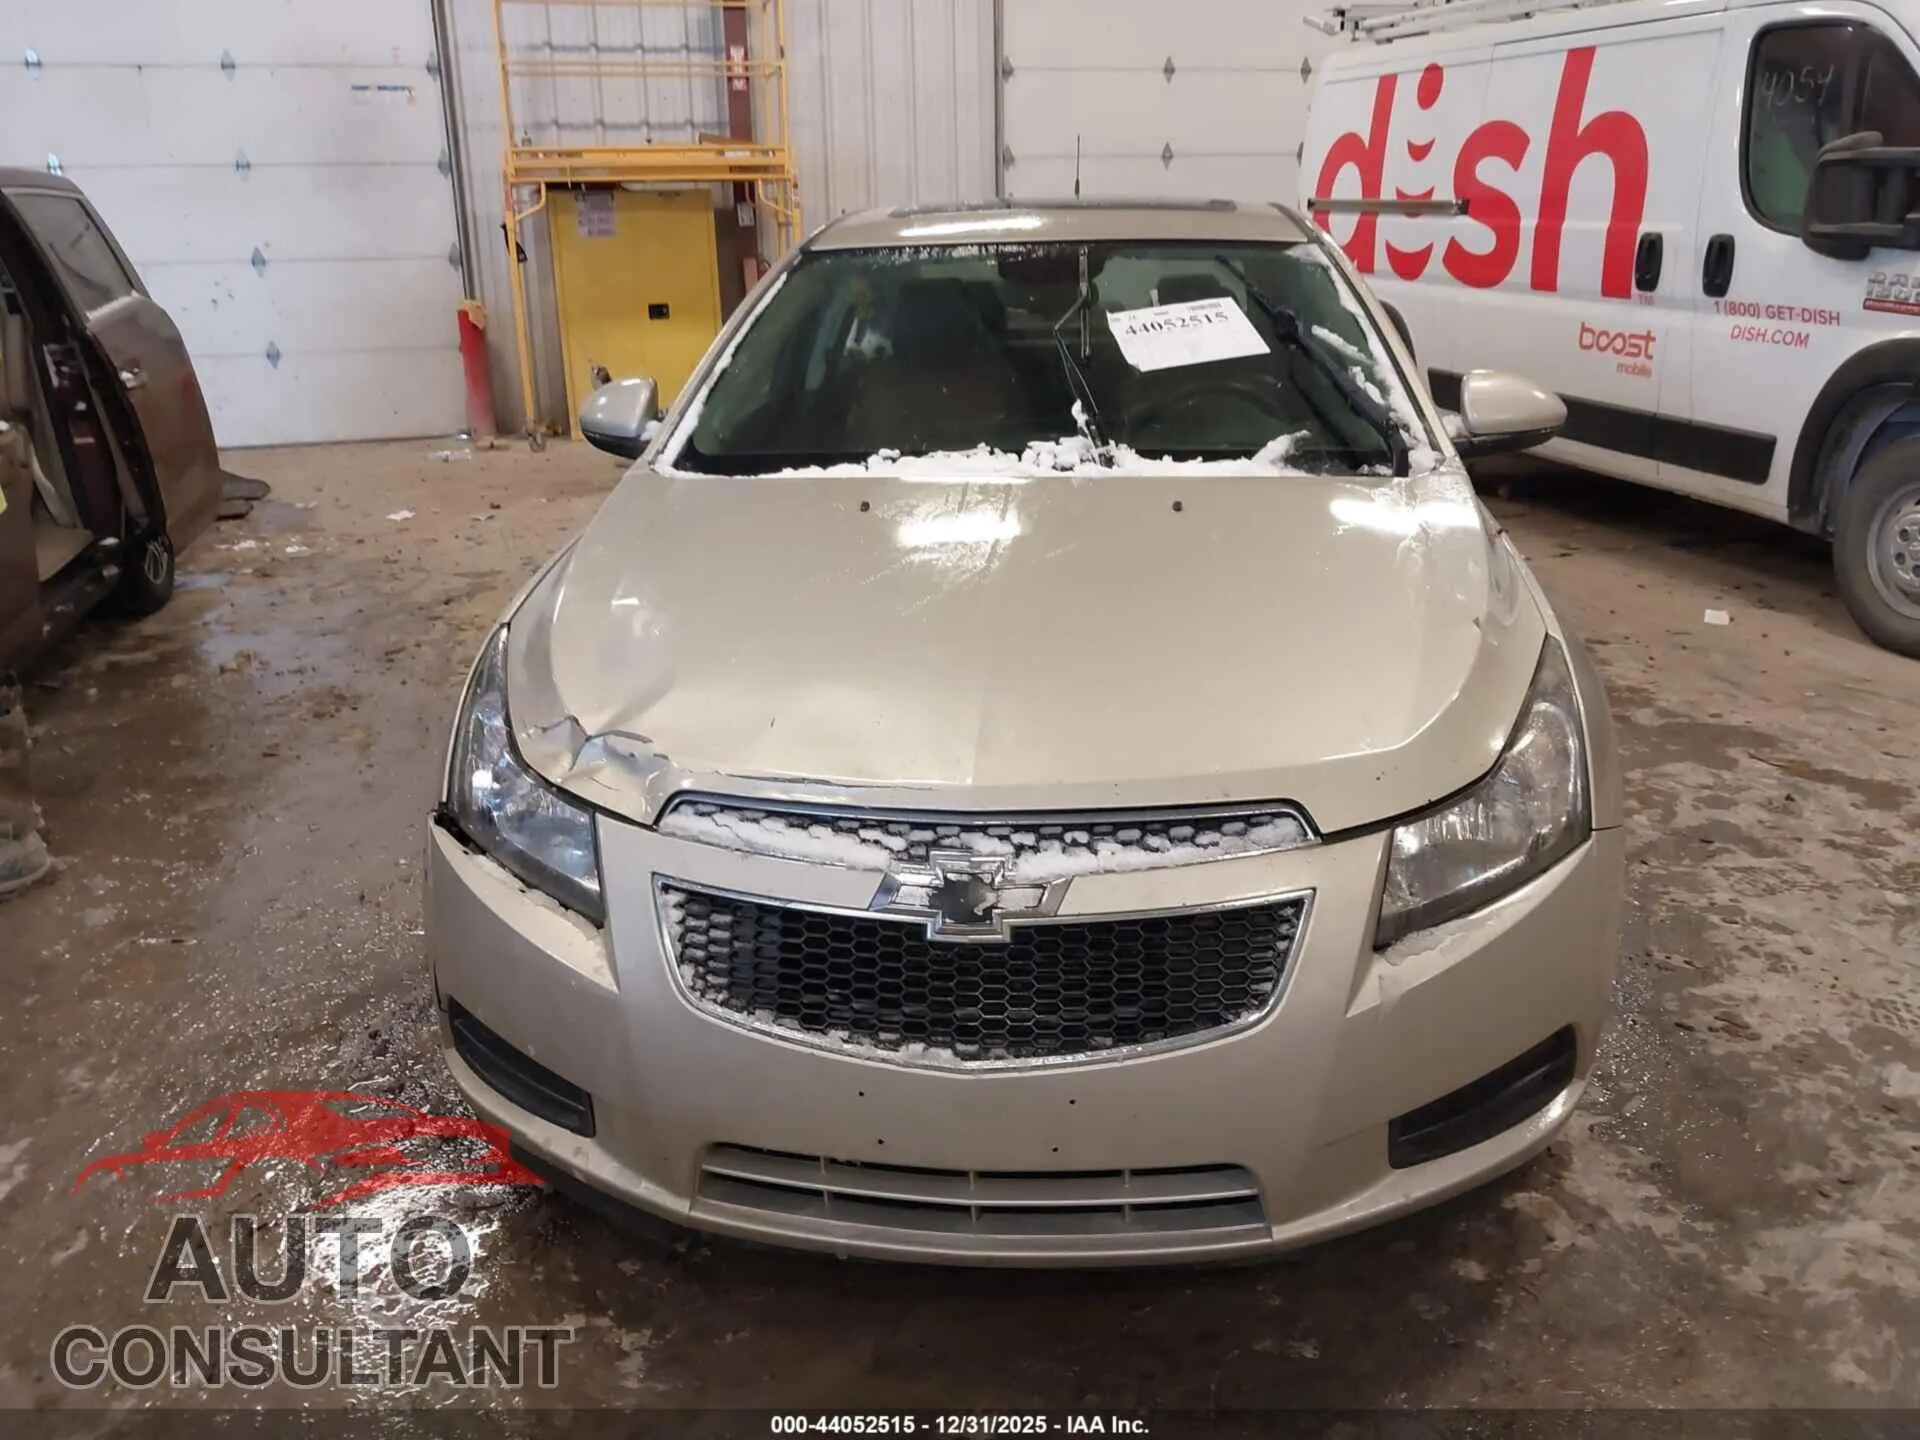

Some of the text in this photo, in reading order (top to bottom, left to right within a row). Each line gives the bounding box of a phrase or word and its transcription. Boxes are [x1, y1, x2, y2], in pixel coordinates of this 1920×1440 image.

[1313, 45, 1648, 299] dish
[1125, 311, 1229, 336] 44052515
[1714, 300, 1840, 326] 1 (800) GET-DISH
[1579, 320, 1656, 360] boost
[1730, 325, 1810, 348] DISH.COM
[1616, 361, 1652, 378] mobile
